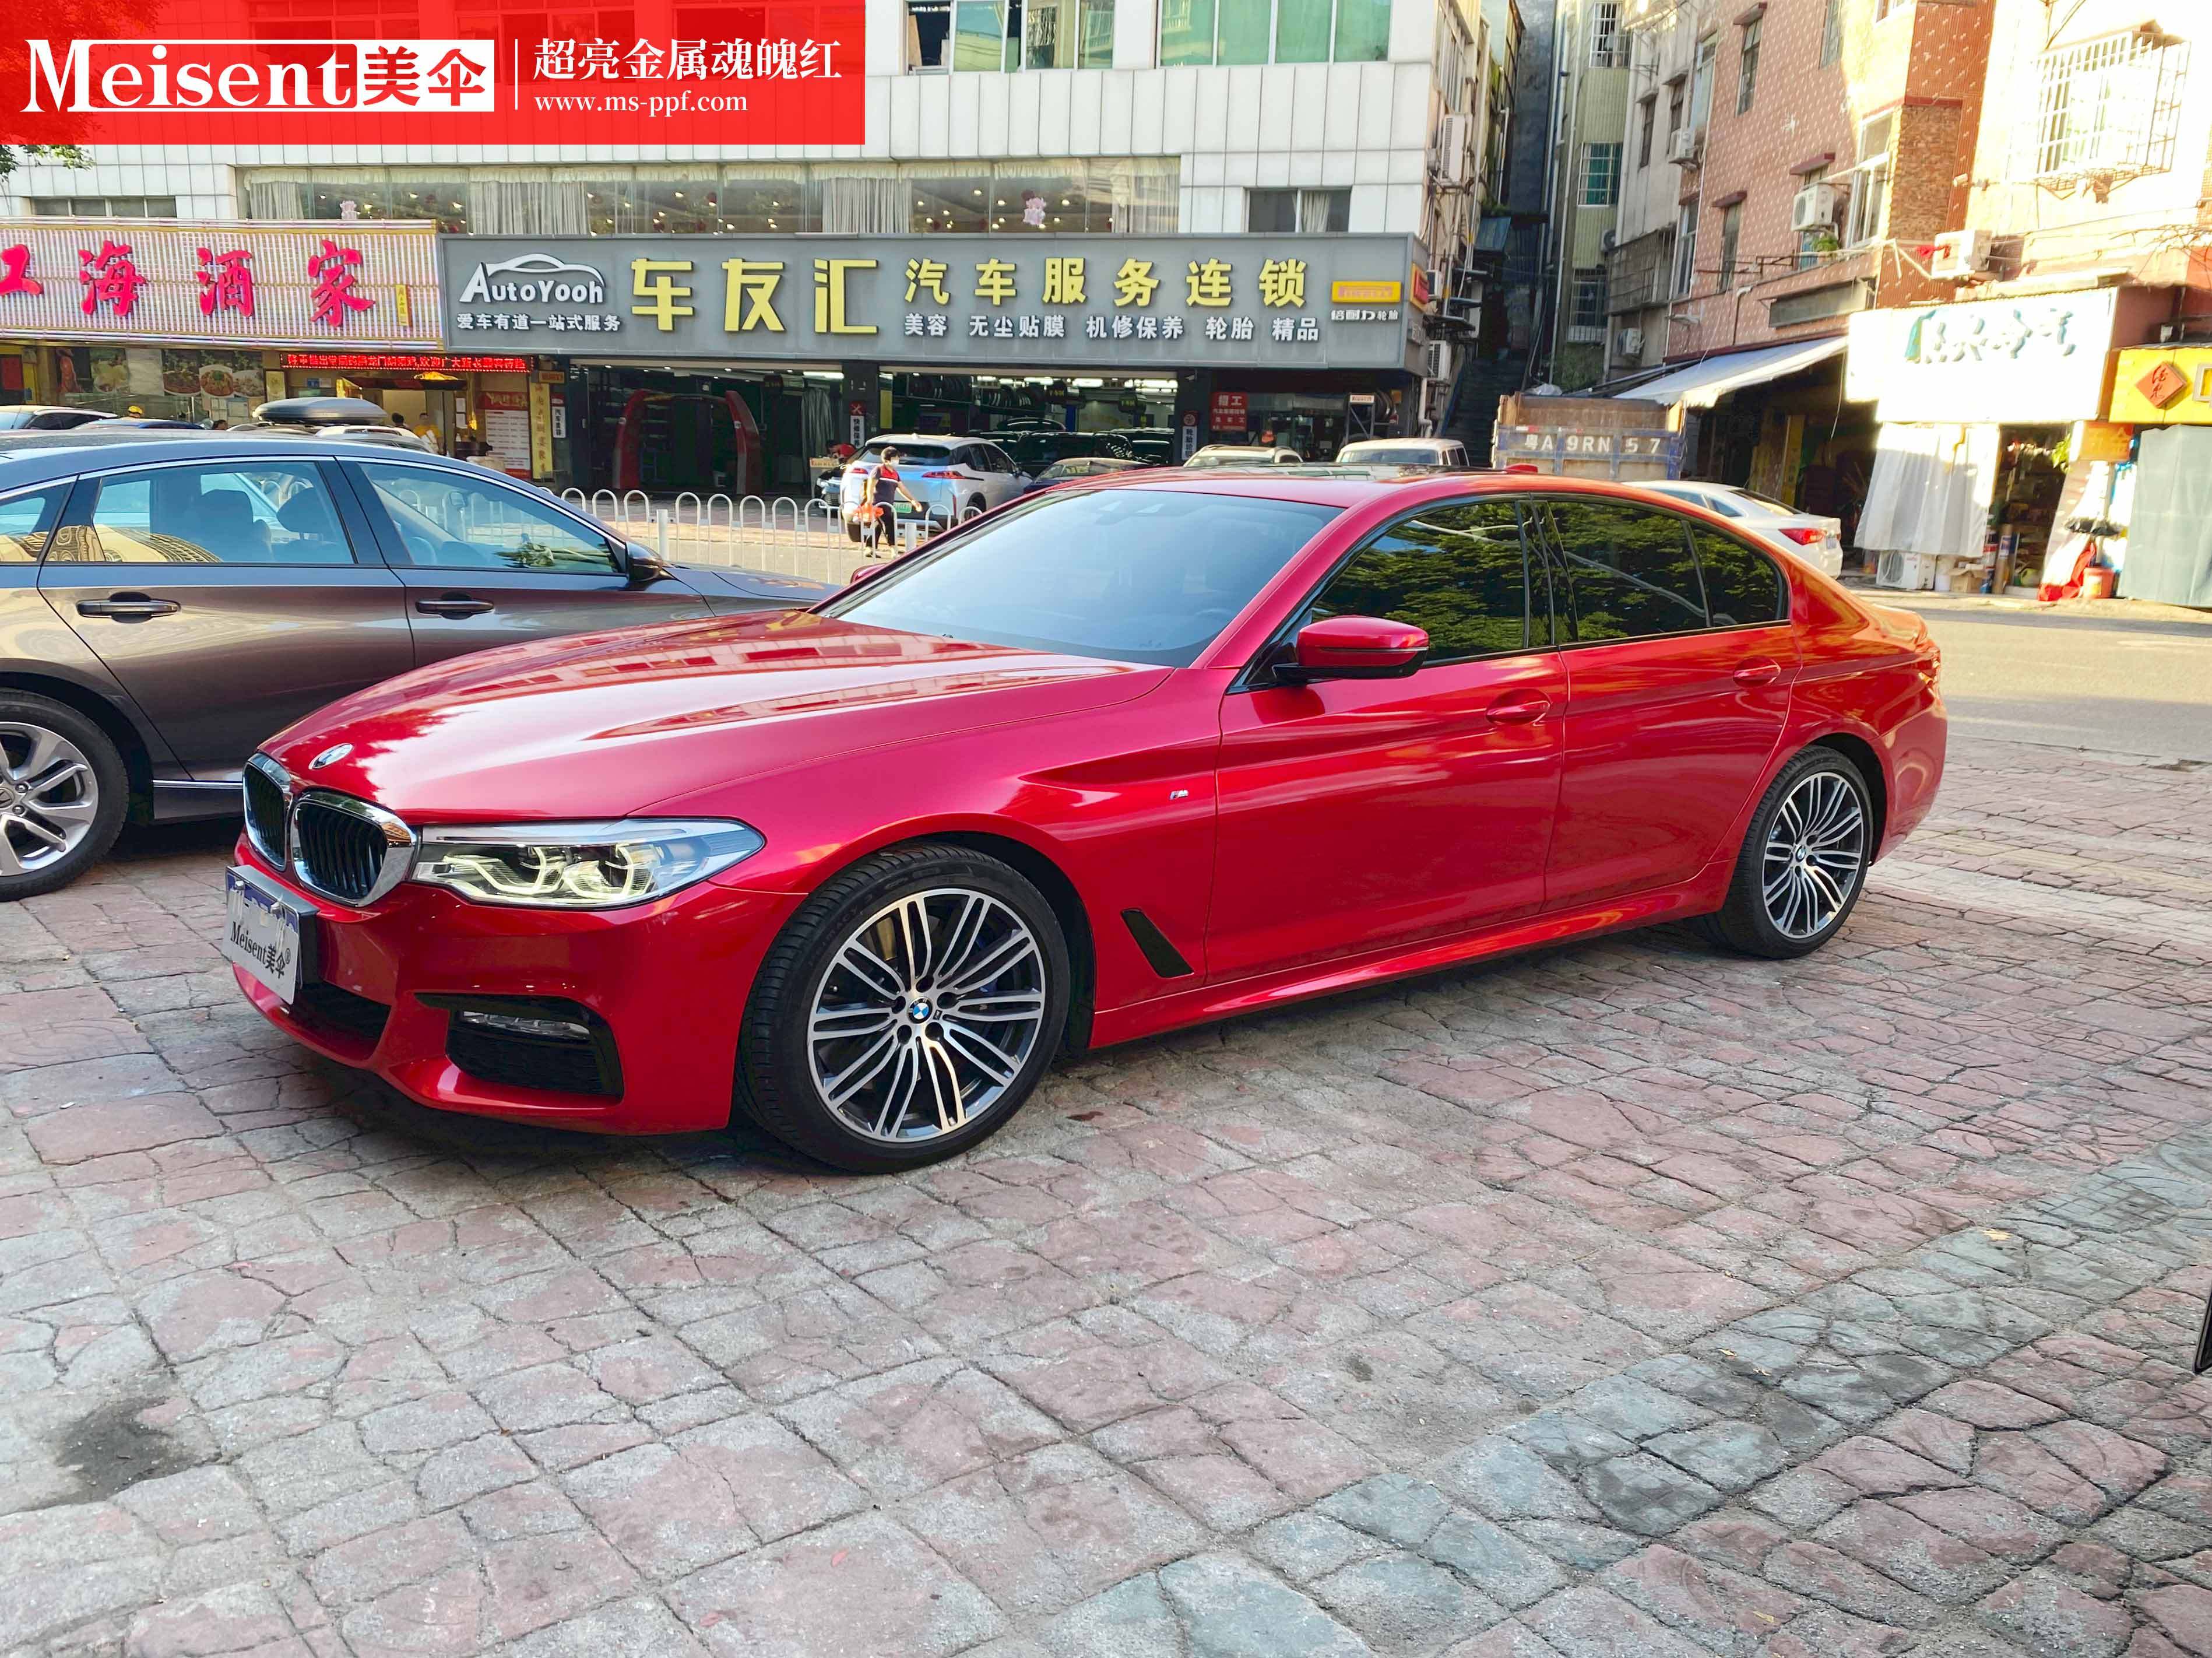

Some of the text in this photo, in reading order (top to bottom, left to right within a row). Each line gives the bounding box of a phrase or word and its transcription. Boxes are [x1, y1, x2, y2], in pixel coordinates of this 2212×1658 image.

[631, 258, 1307, 333] 车友汇 汽车服务连锁
[456, 312, 621, 332] 爱车有道一站式服务
[905, 314, 1318, 341] 美容 无尘贴膜 机修保养 轮胎 精品
